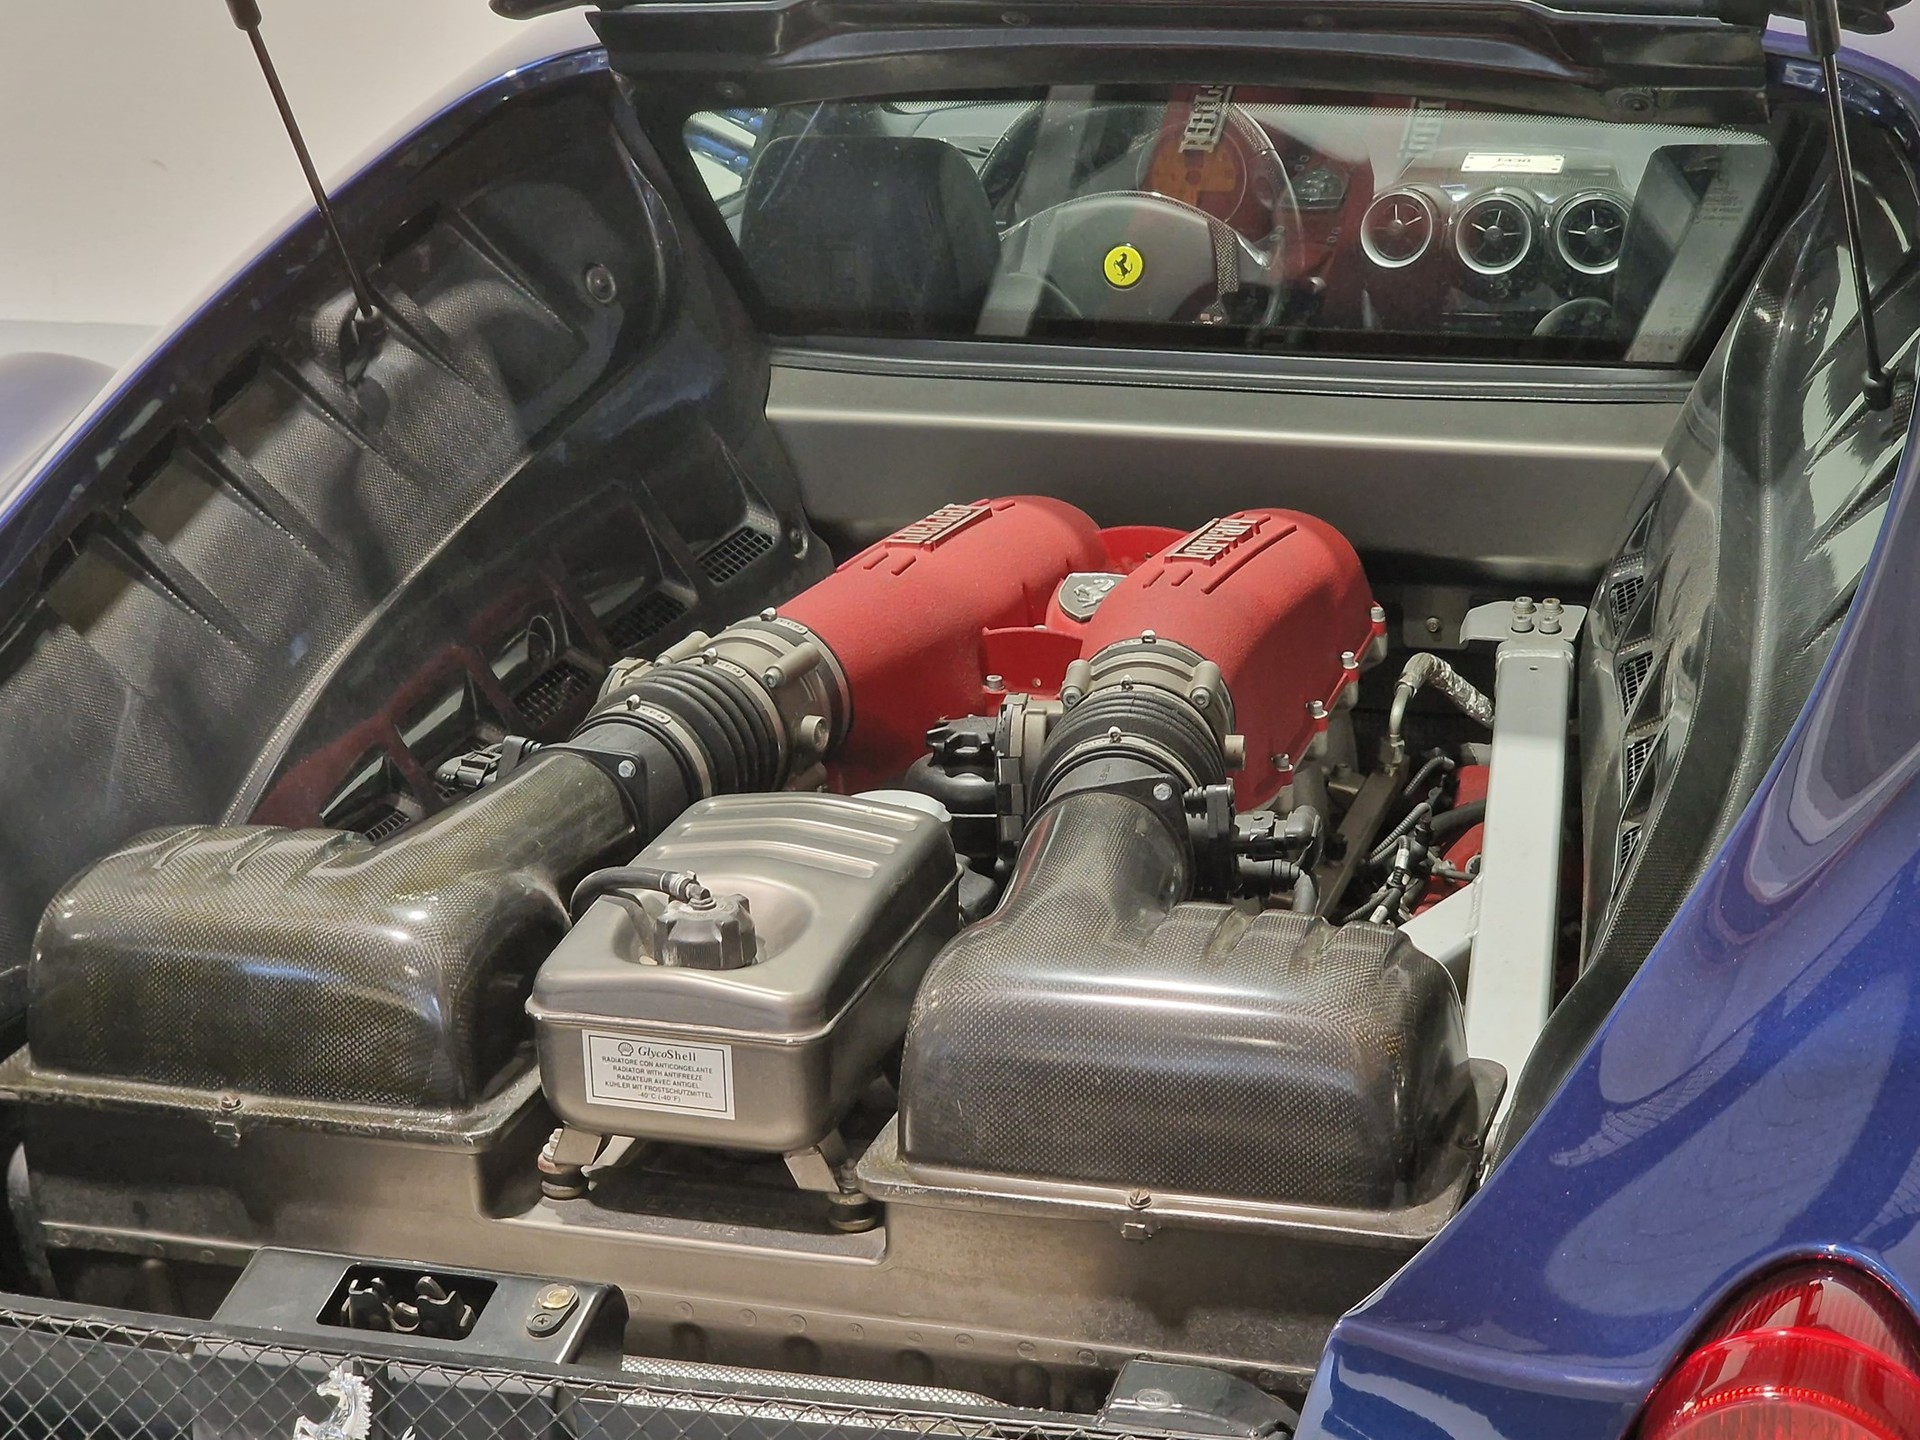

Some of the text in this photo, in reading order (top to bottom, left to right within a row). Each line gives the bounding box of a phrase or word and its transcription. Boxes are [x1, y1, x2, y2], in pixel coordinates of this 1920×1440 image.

[638, 1046, 696, 1061] GlycoShell
[601, 1056, 638, 1065] RADIATORE
[655, 1062, 712, 1074] ANTICONGELANTE
[613, 1065, 645, 1074] RADIATOR
[664, 1072, 703, 1081] ANTIFREEZE
[616, 1074, 652, 1083] RADIATEUR
[672, 1080, 700, 1089] ANTIGEL
[644, 1085, 713, 1099] FROSTSCHUTZMITTEL
